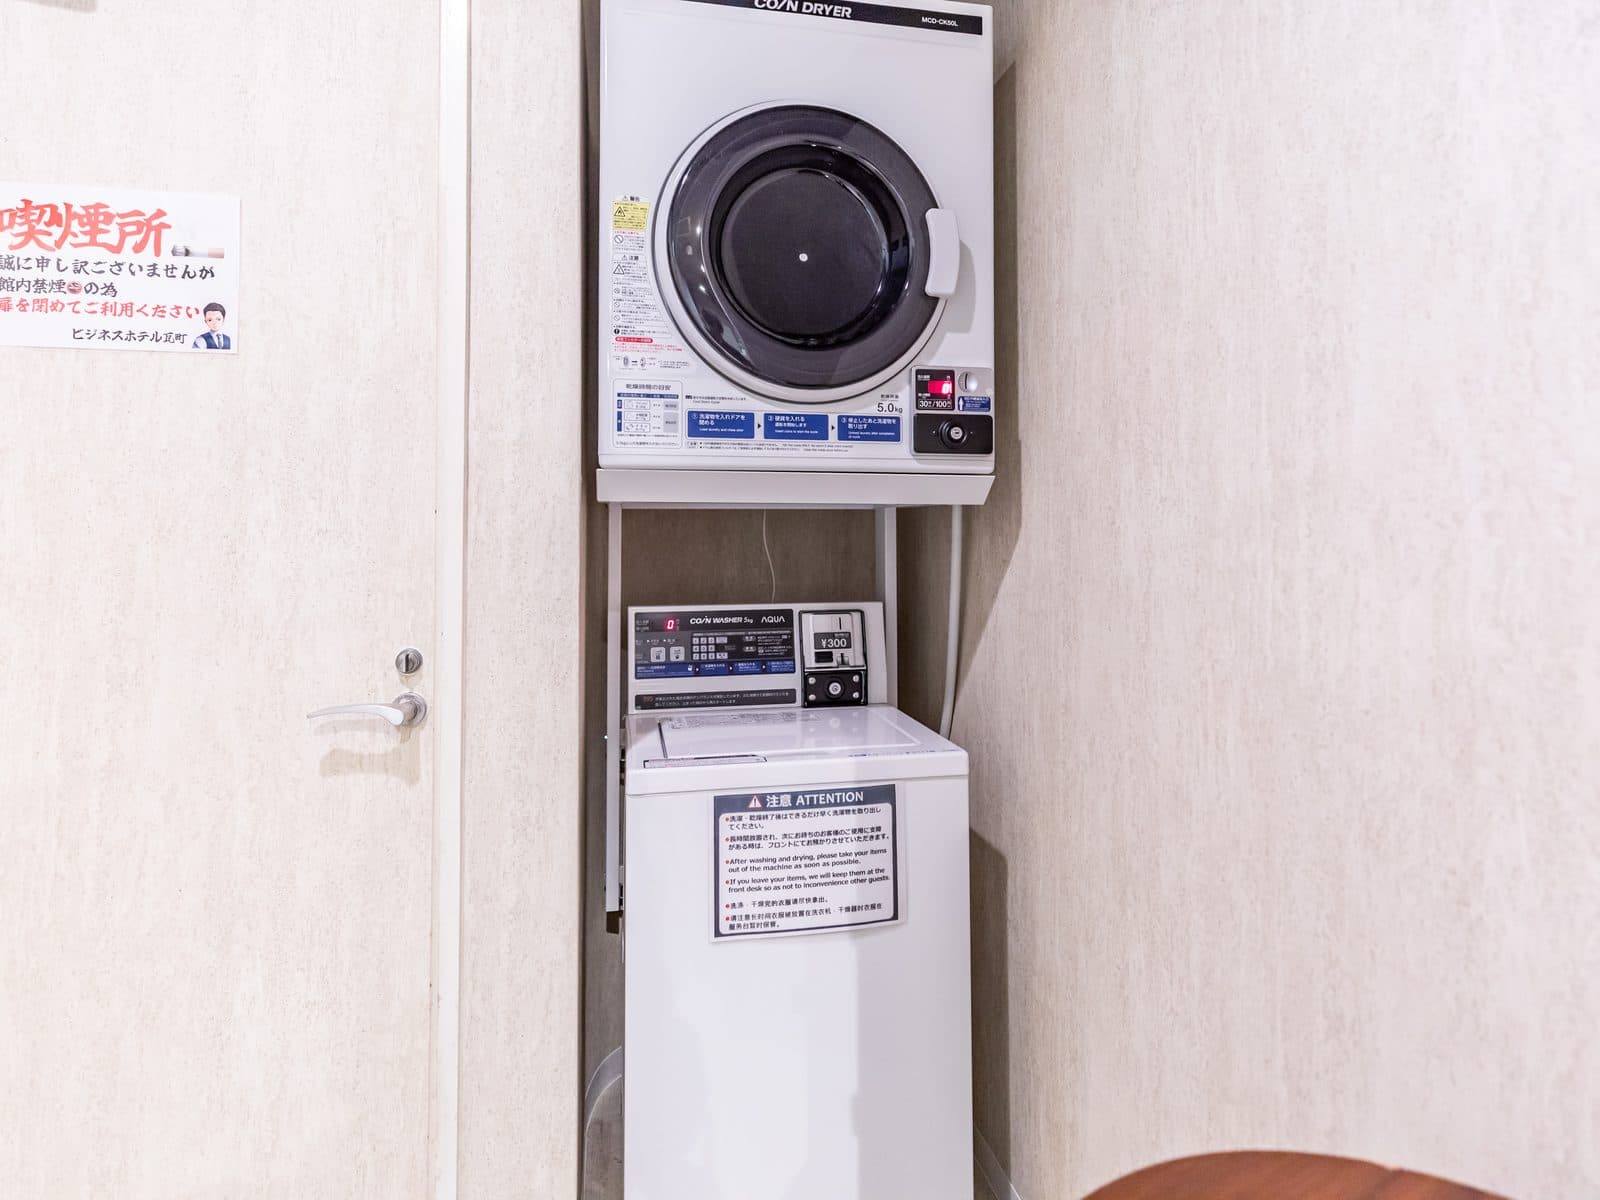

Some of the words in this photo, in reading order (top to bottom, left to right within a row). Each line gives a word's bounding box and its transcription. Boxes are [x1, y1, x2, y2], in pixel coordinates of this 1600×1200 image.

[754, 0, 799, 12] COIN
[801, 2, 852, 18] DRYER
[0, 198, 172, 257] 喫煙所
[0, 254, 215, 280] 誠に申し訳ございませんが
[0, 276, 67, 294] 館内禁煙
[84, 281, 118, 298] の為
[0, 297, 200, 319] 扉を閉めてご利用ください
[72, 328, 188, 344] ビジネスホテル瓦町
[877, 402, 903, 413] 5.0kg
[667, 620, 674, 629] 0
[690, 616, 712, 625] COIN
[713, 616, 742, 624] WASHER
[821, 638, 847, 649] ¥300
[766, 794, 792, 808] 注意
[796, 791, 864, 806] ATTENTION
[749, 856, 776, 866] washing
[778, 855, 790, 863] and
[792, 853, 815, 863] drying,
[816, 852, 837, 862] please
[854, 850, 868, 858] your
[870, 848, 887, 856] items
[763, 862, 792, 871] machine
[803, 861, 820, 869] soon
[831, 858, 861, 868] possible.
[736, 879, 750, 887] you
[751, 876, 769, 884] leave
[770, 876, 785, 884] your
[786, 874, 807, 883] items,
[819, 871, 831, 879] will
[832, 871, 848, 880] keep
[746, 884, 762, 892] desk
[782, 882, 794, 890] not
[803, 878, 849, 888] inconvenience
[850, 877, 868, 885] other
[868, 875, 890, 885] guests.
